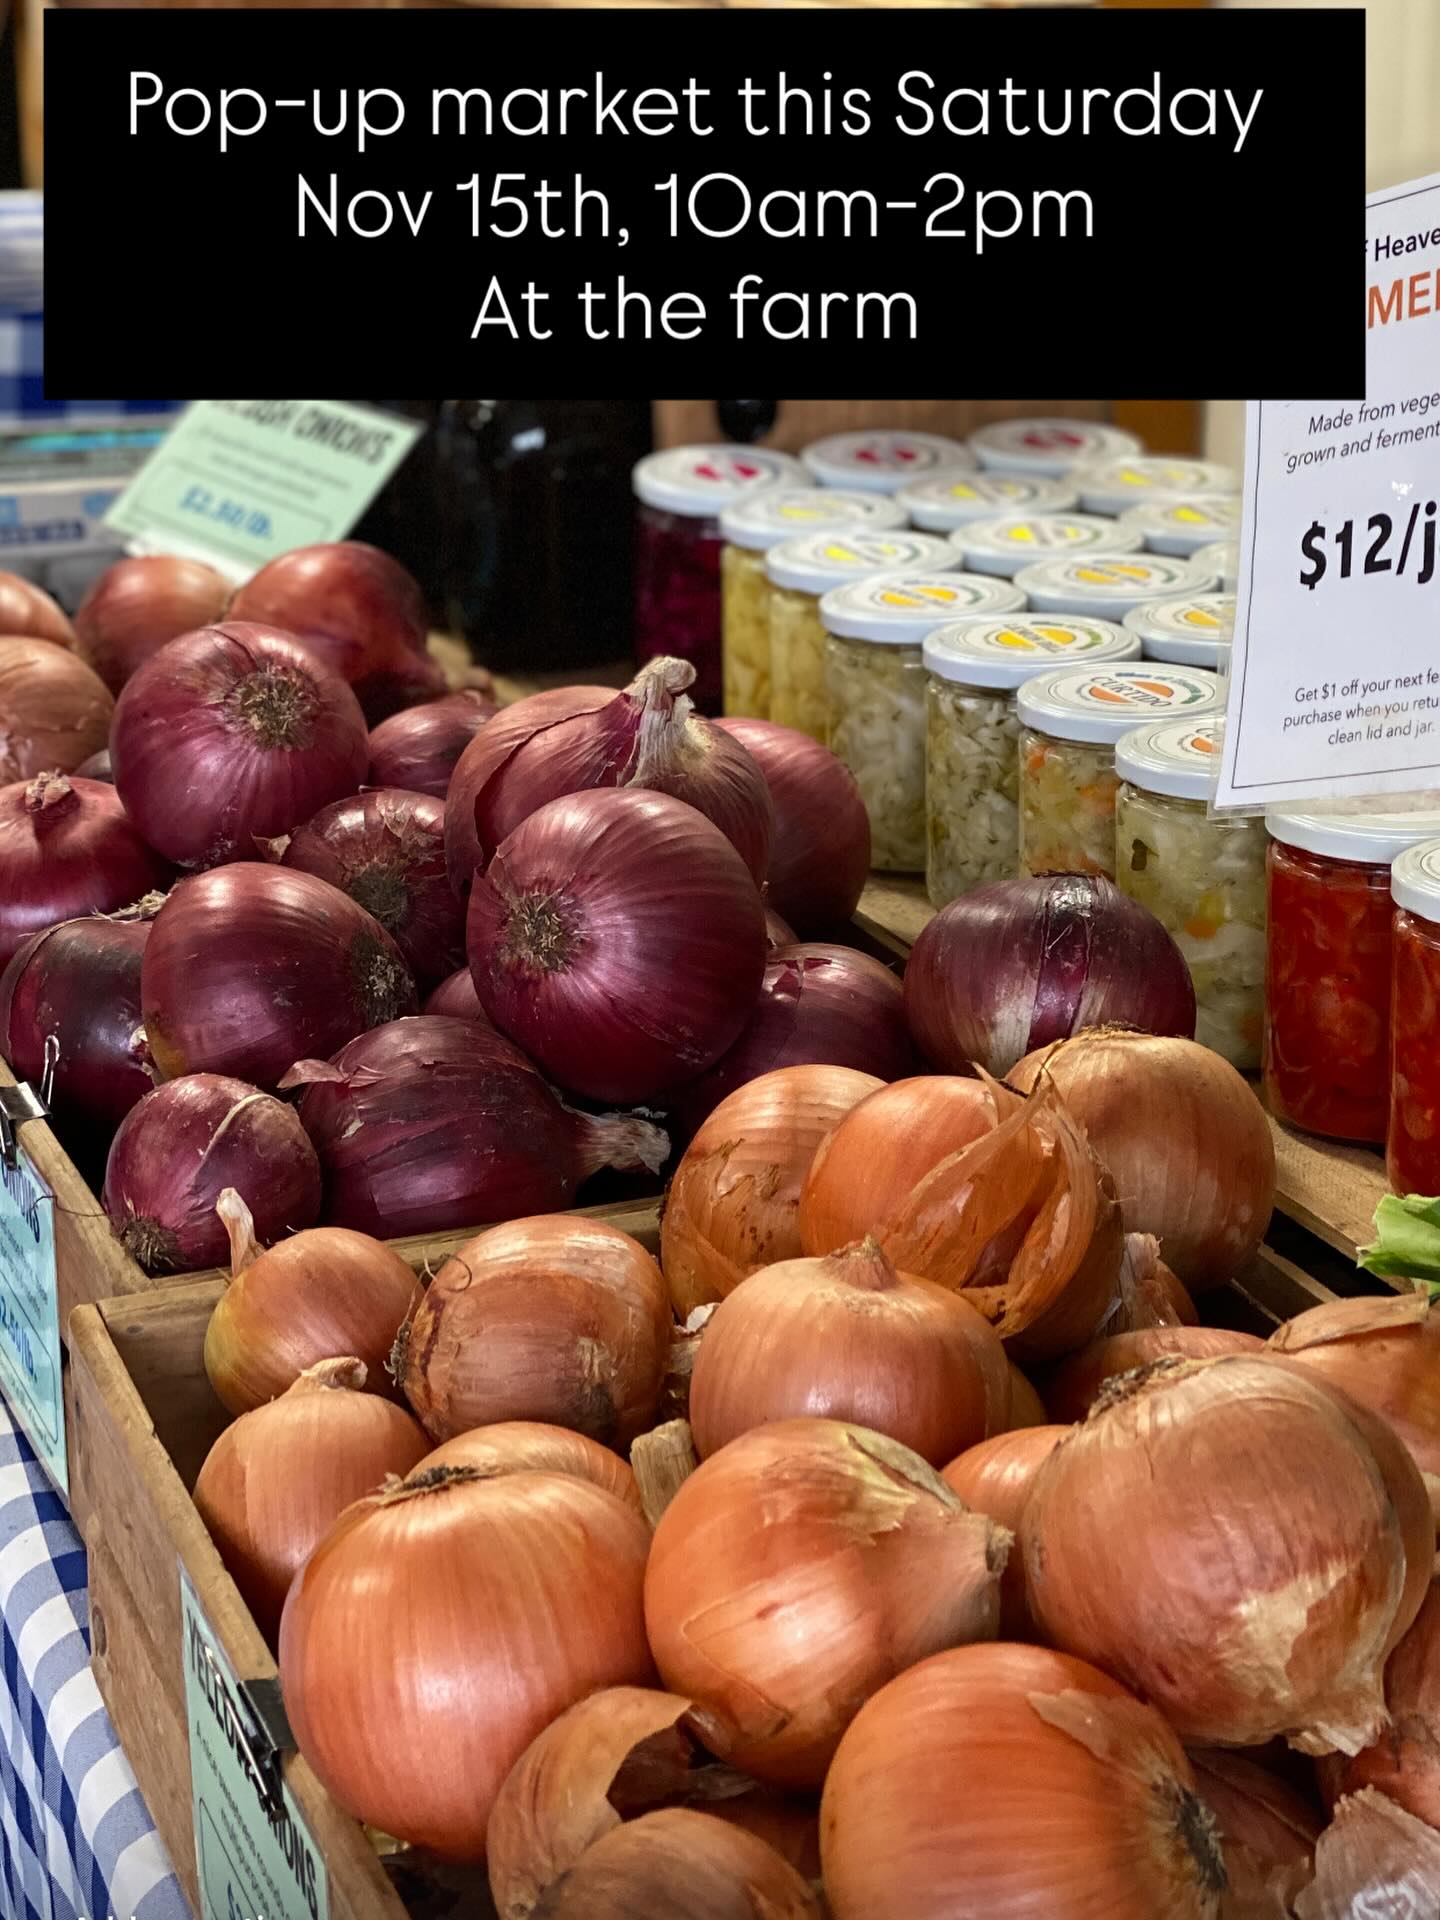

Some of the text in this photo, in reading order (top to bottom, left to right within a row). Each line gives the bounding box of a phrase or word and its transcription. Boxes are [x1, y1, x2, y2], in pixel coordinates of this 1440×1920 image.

[1368, 268, 1440, 330] ME
[1308, 392, 1440, 435] Made from vege
[1286, 421, 1440, 474] grown and ferment
[1300, 500, 1440, 590] $12/j
[1090, 676, 1172, 707] CURTIDO
[1295, 687, 1318, 703] Get
[1321, 683, 1337, 700] $1
[1341, 678, 1359, 697] off
[1361, 679, 1390, 698] your
[1395, 670, 1422, 689] next
[1283, 707, 1342, 731] purchase
[1346, 704, 1380, 720] when
[1384, 701, 1409, 718] you
[1328, 720, 1436, 745] clean lid and jar.
